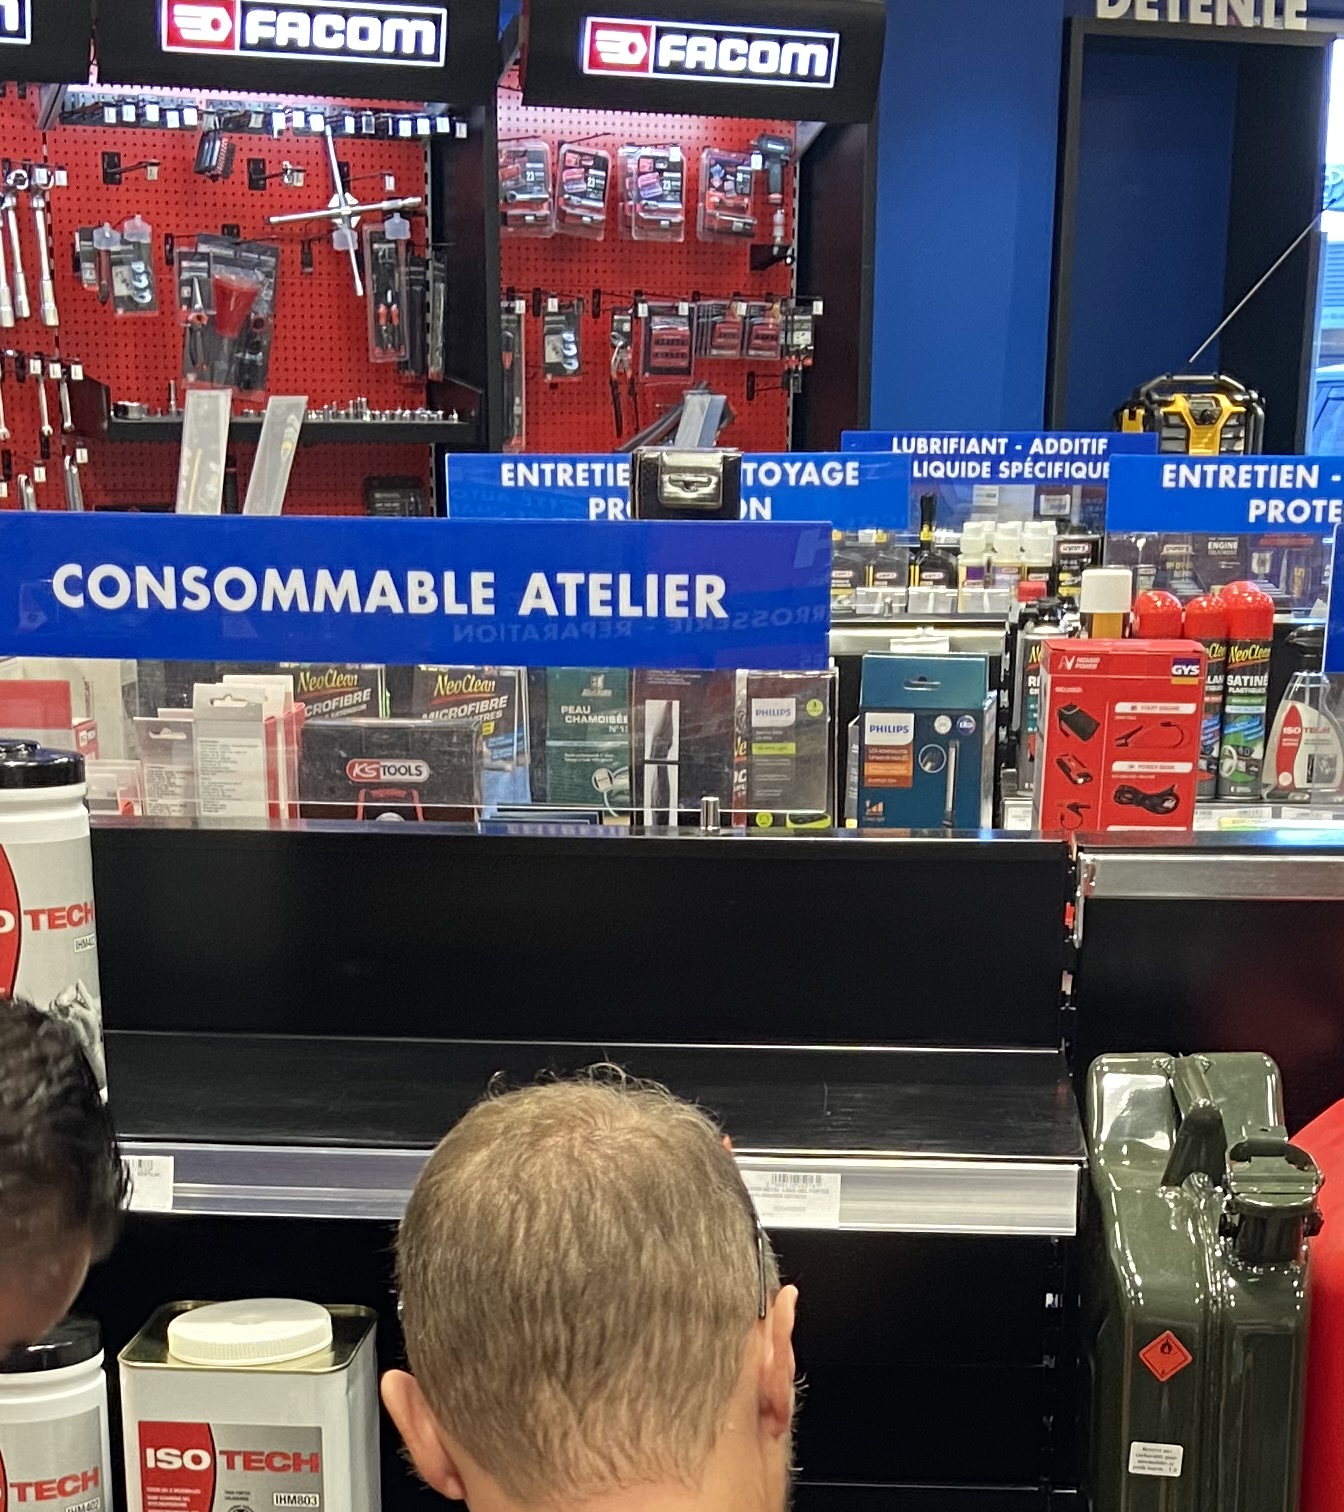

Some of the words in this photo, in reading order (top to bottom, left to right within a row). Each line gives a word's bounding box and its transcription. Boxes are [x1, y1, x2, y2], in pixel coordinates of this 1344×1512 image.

[245, 9, 437, 57] FACOM
[658, 33, 830, 76] FACOM
[891, 436, 1008, 456] LUBRIFIANT
[1029, 436, 1108, 456] ADDITIF
[500, 461, 630, 488] ENTRETIE
[741, 461, 860, 488] TOYAGE
[912, 460, 992, 480] LIQUIDE
[998, 457, 1110, 480] SPÉCIFIQUE
[1161, 463, 1319, 489] ENTRETIEN
[52, 563, 496, 615] CONSOMMABLE
[517, 571, 729, 618] ATELIER
[297, 667, 359, 694] NeoClean
[1171, 664, 1200, 675] GYS
[1226, 672, 1268, 687] SATINÉ
[433, 673, 496, 697] NeoClean
[304, 688, 372, 717] CROFIBRE
[561, 704, 591, 715] PEAU
[755, 708, 792, 718] PHILIPS
[869, 724, 910, 734] PHILIPS
[1282, 727, 1302, 735] ISO
[23, 901, 95, 932] TECH
[145, 1447, 211, 1471] ISO
[219, 1450, 320, 1474] TECH
[9, 1465, 100, 1503] TECH
[275, 1493, 317, 1507] IHM803
